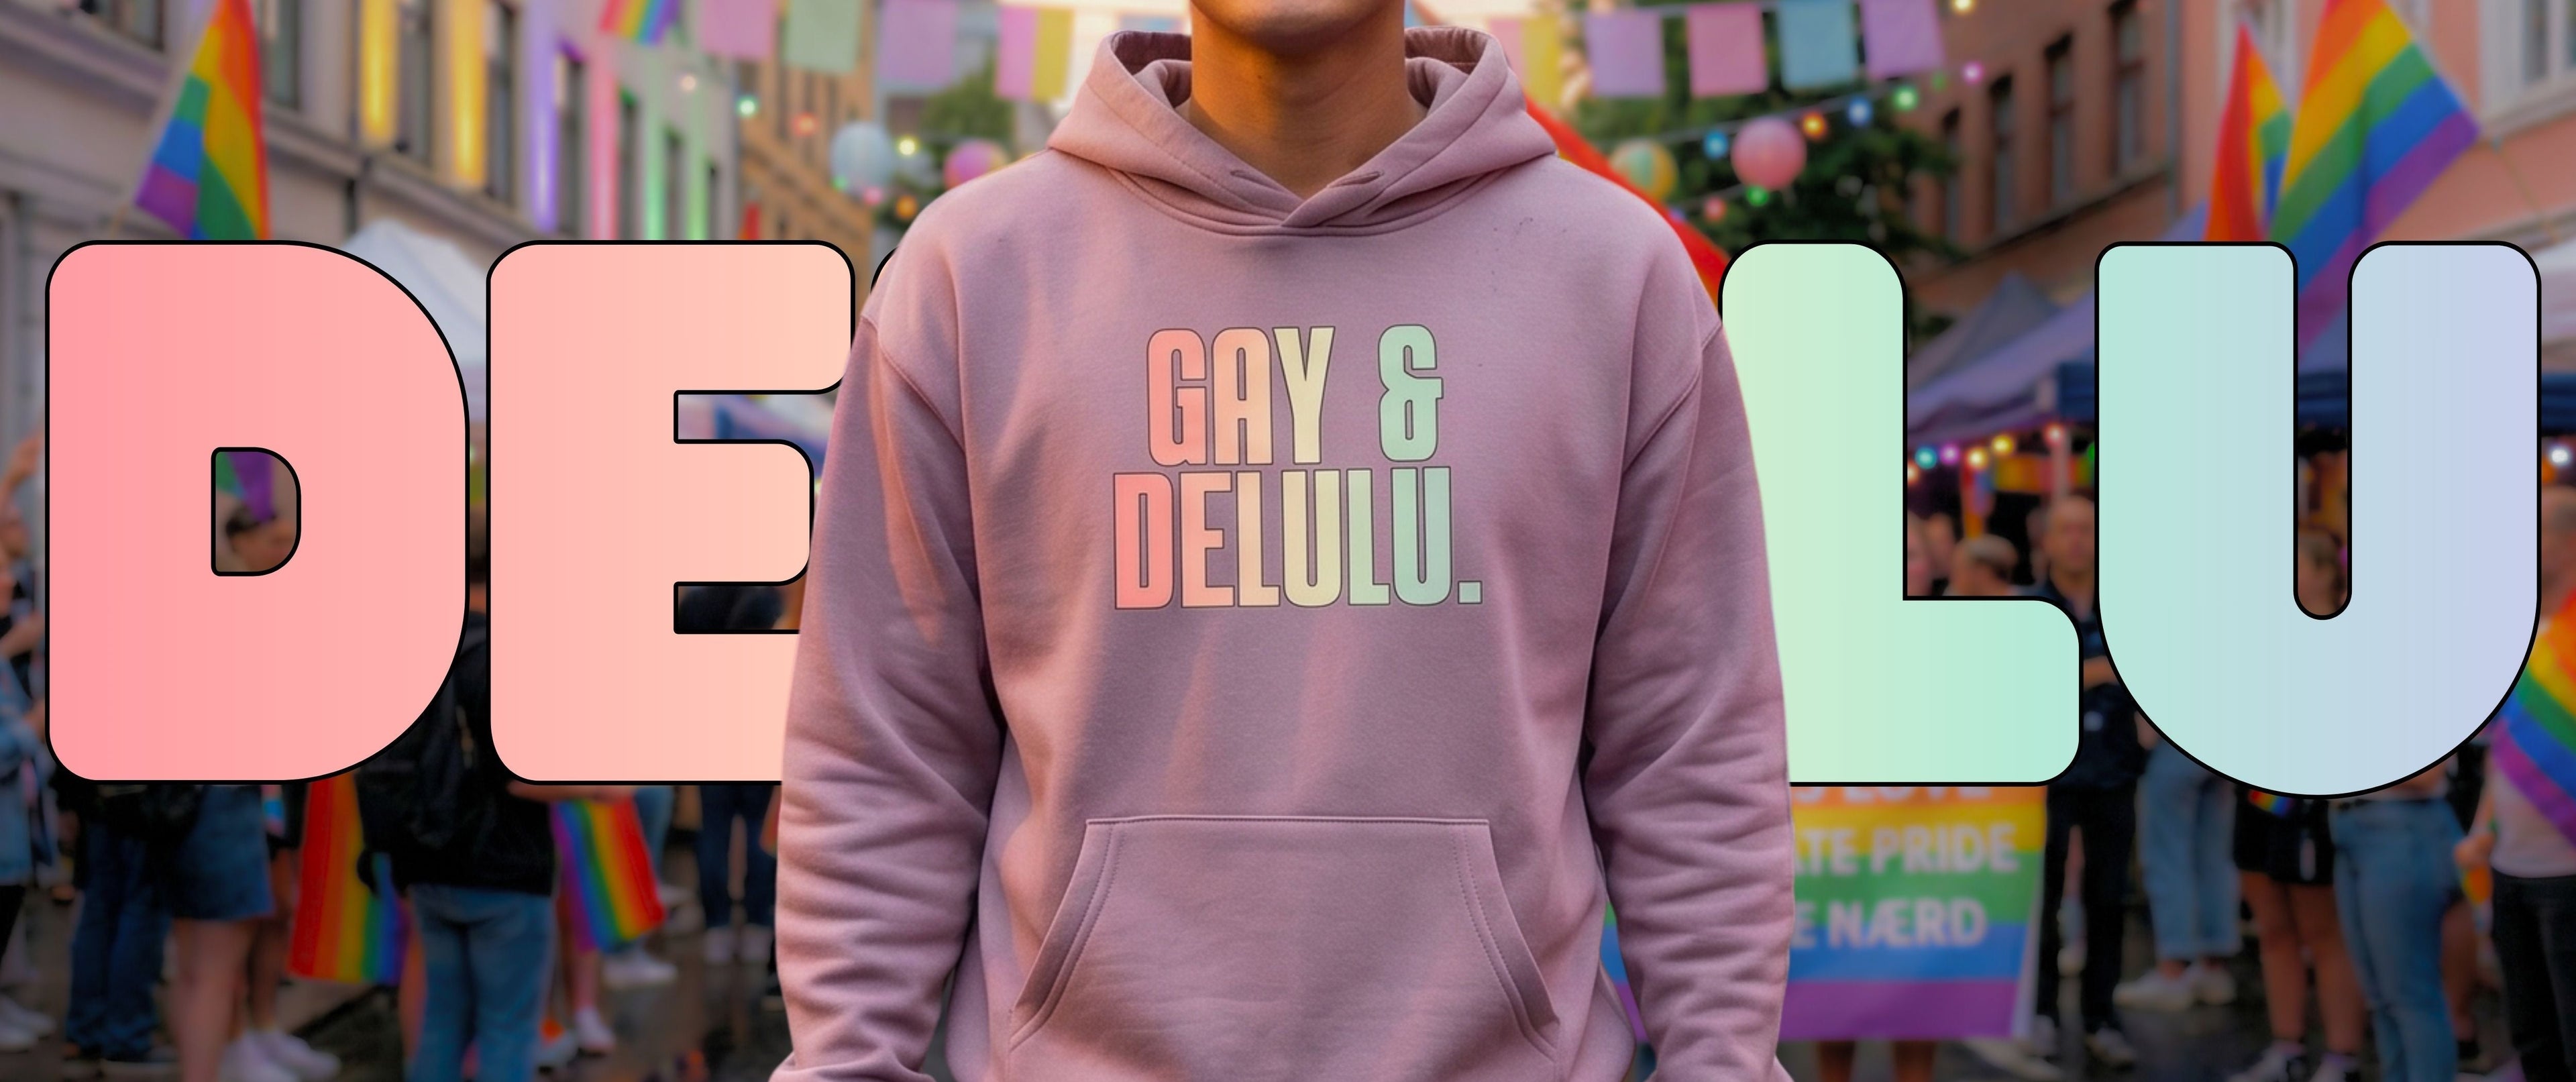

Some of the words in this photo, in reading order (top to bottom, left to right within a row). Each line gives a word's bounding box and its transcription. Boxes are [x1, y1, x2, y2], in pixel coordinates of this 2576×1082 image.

[1146, 325, 1336, 467] GAY
[1378, 324, 1444, 462] &
[1113, 466, 1483, 610] DELULU.
[1870, 822, 2018, 875] PRIDE
[1829, 897, 1986, 949] NÆRD
